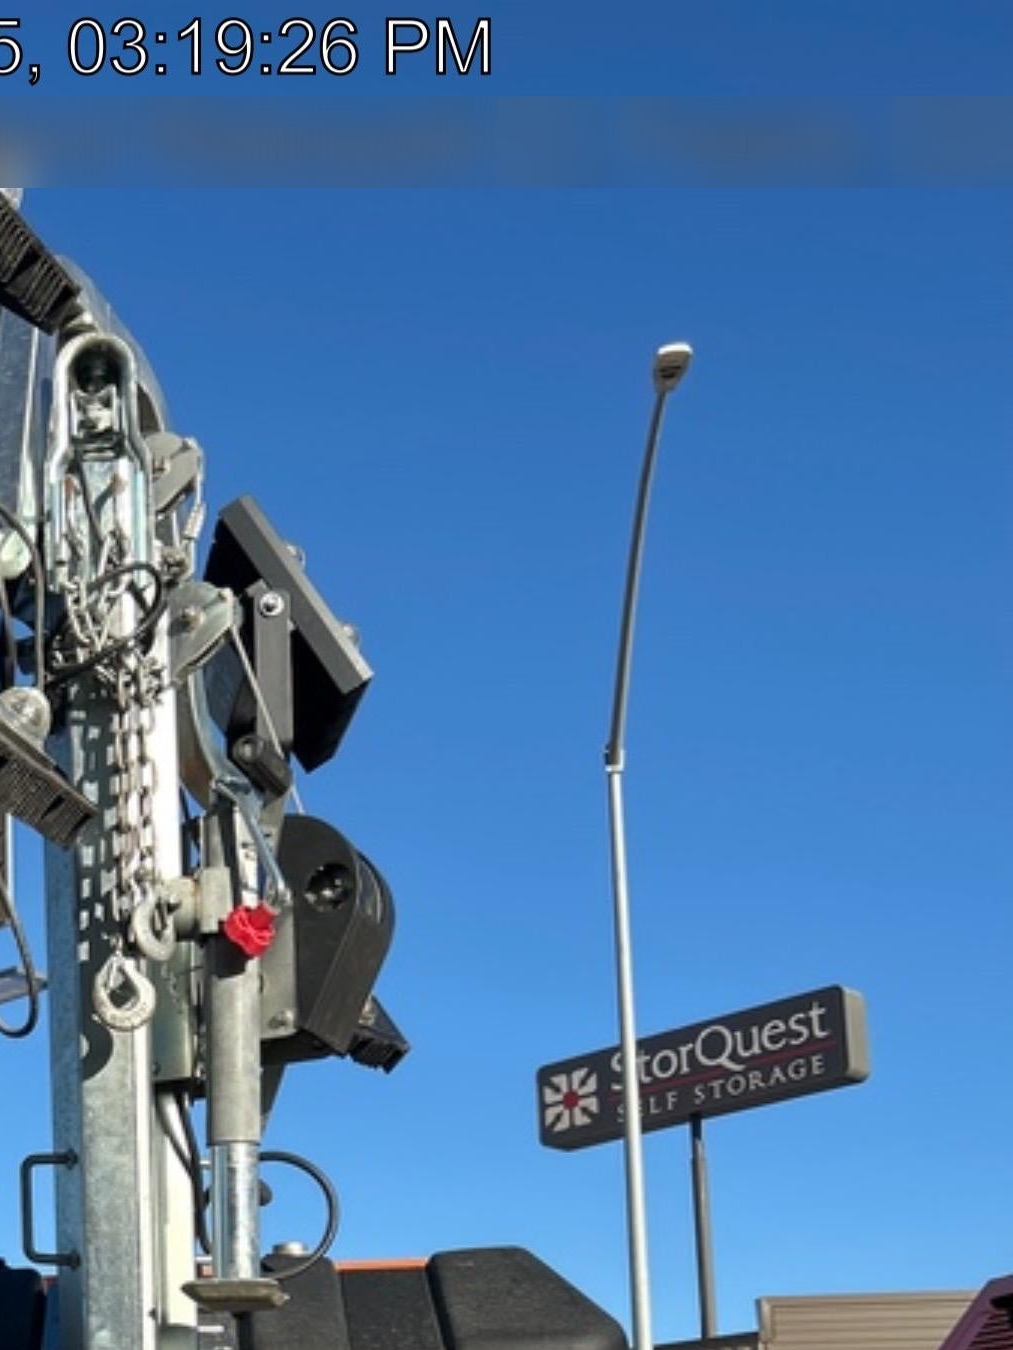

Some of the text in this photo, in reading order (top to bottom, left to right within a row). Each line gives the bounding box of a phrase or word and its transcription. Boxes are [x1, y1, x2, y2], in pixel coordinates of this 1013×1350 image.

[610, 1000, 831, 1090] StorQuest
[616, 1054, 826, 1123] SLF STORAGE
